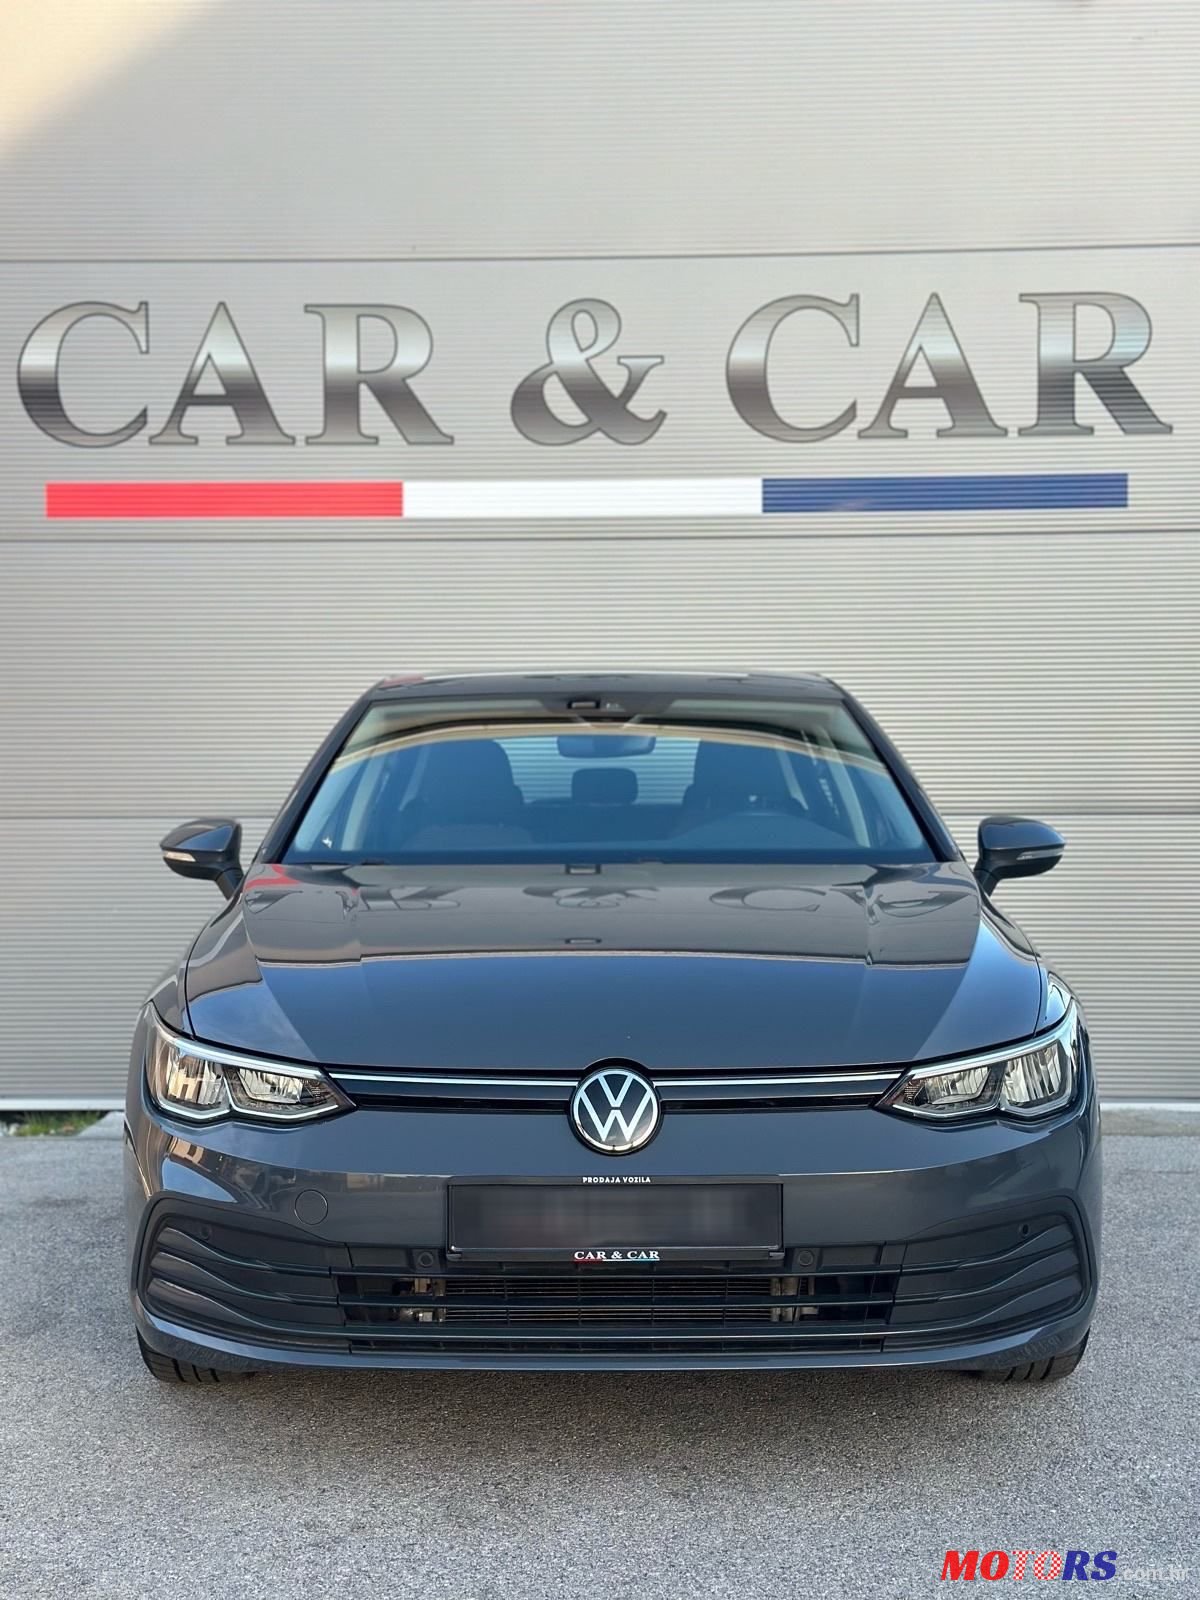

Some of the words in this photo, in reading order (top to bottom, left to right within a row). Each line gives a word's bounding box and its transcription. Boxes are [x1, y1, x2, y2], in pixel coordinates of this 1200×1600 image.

[17, 300, 454, 448] CAR
[510, 298, 667, 445] &
[725, 292, 1173, 443] CAR
[574, 1251, 606, 1259] CAR
[611, 1250, 622, 1259] &
[627, 1250, 659, 1259] CAR
